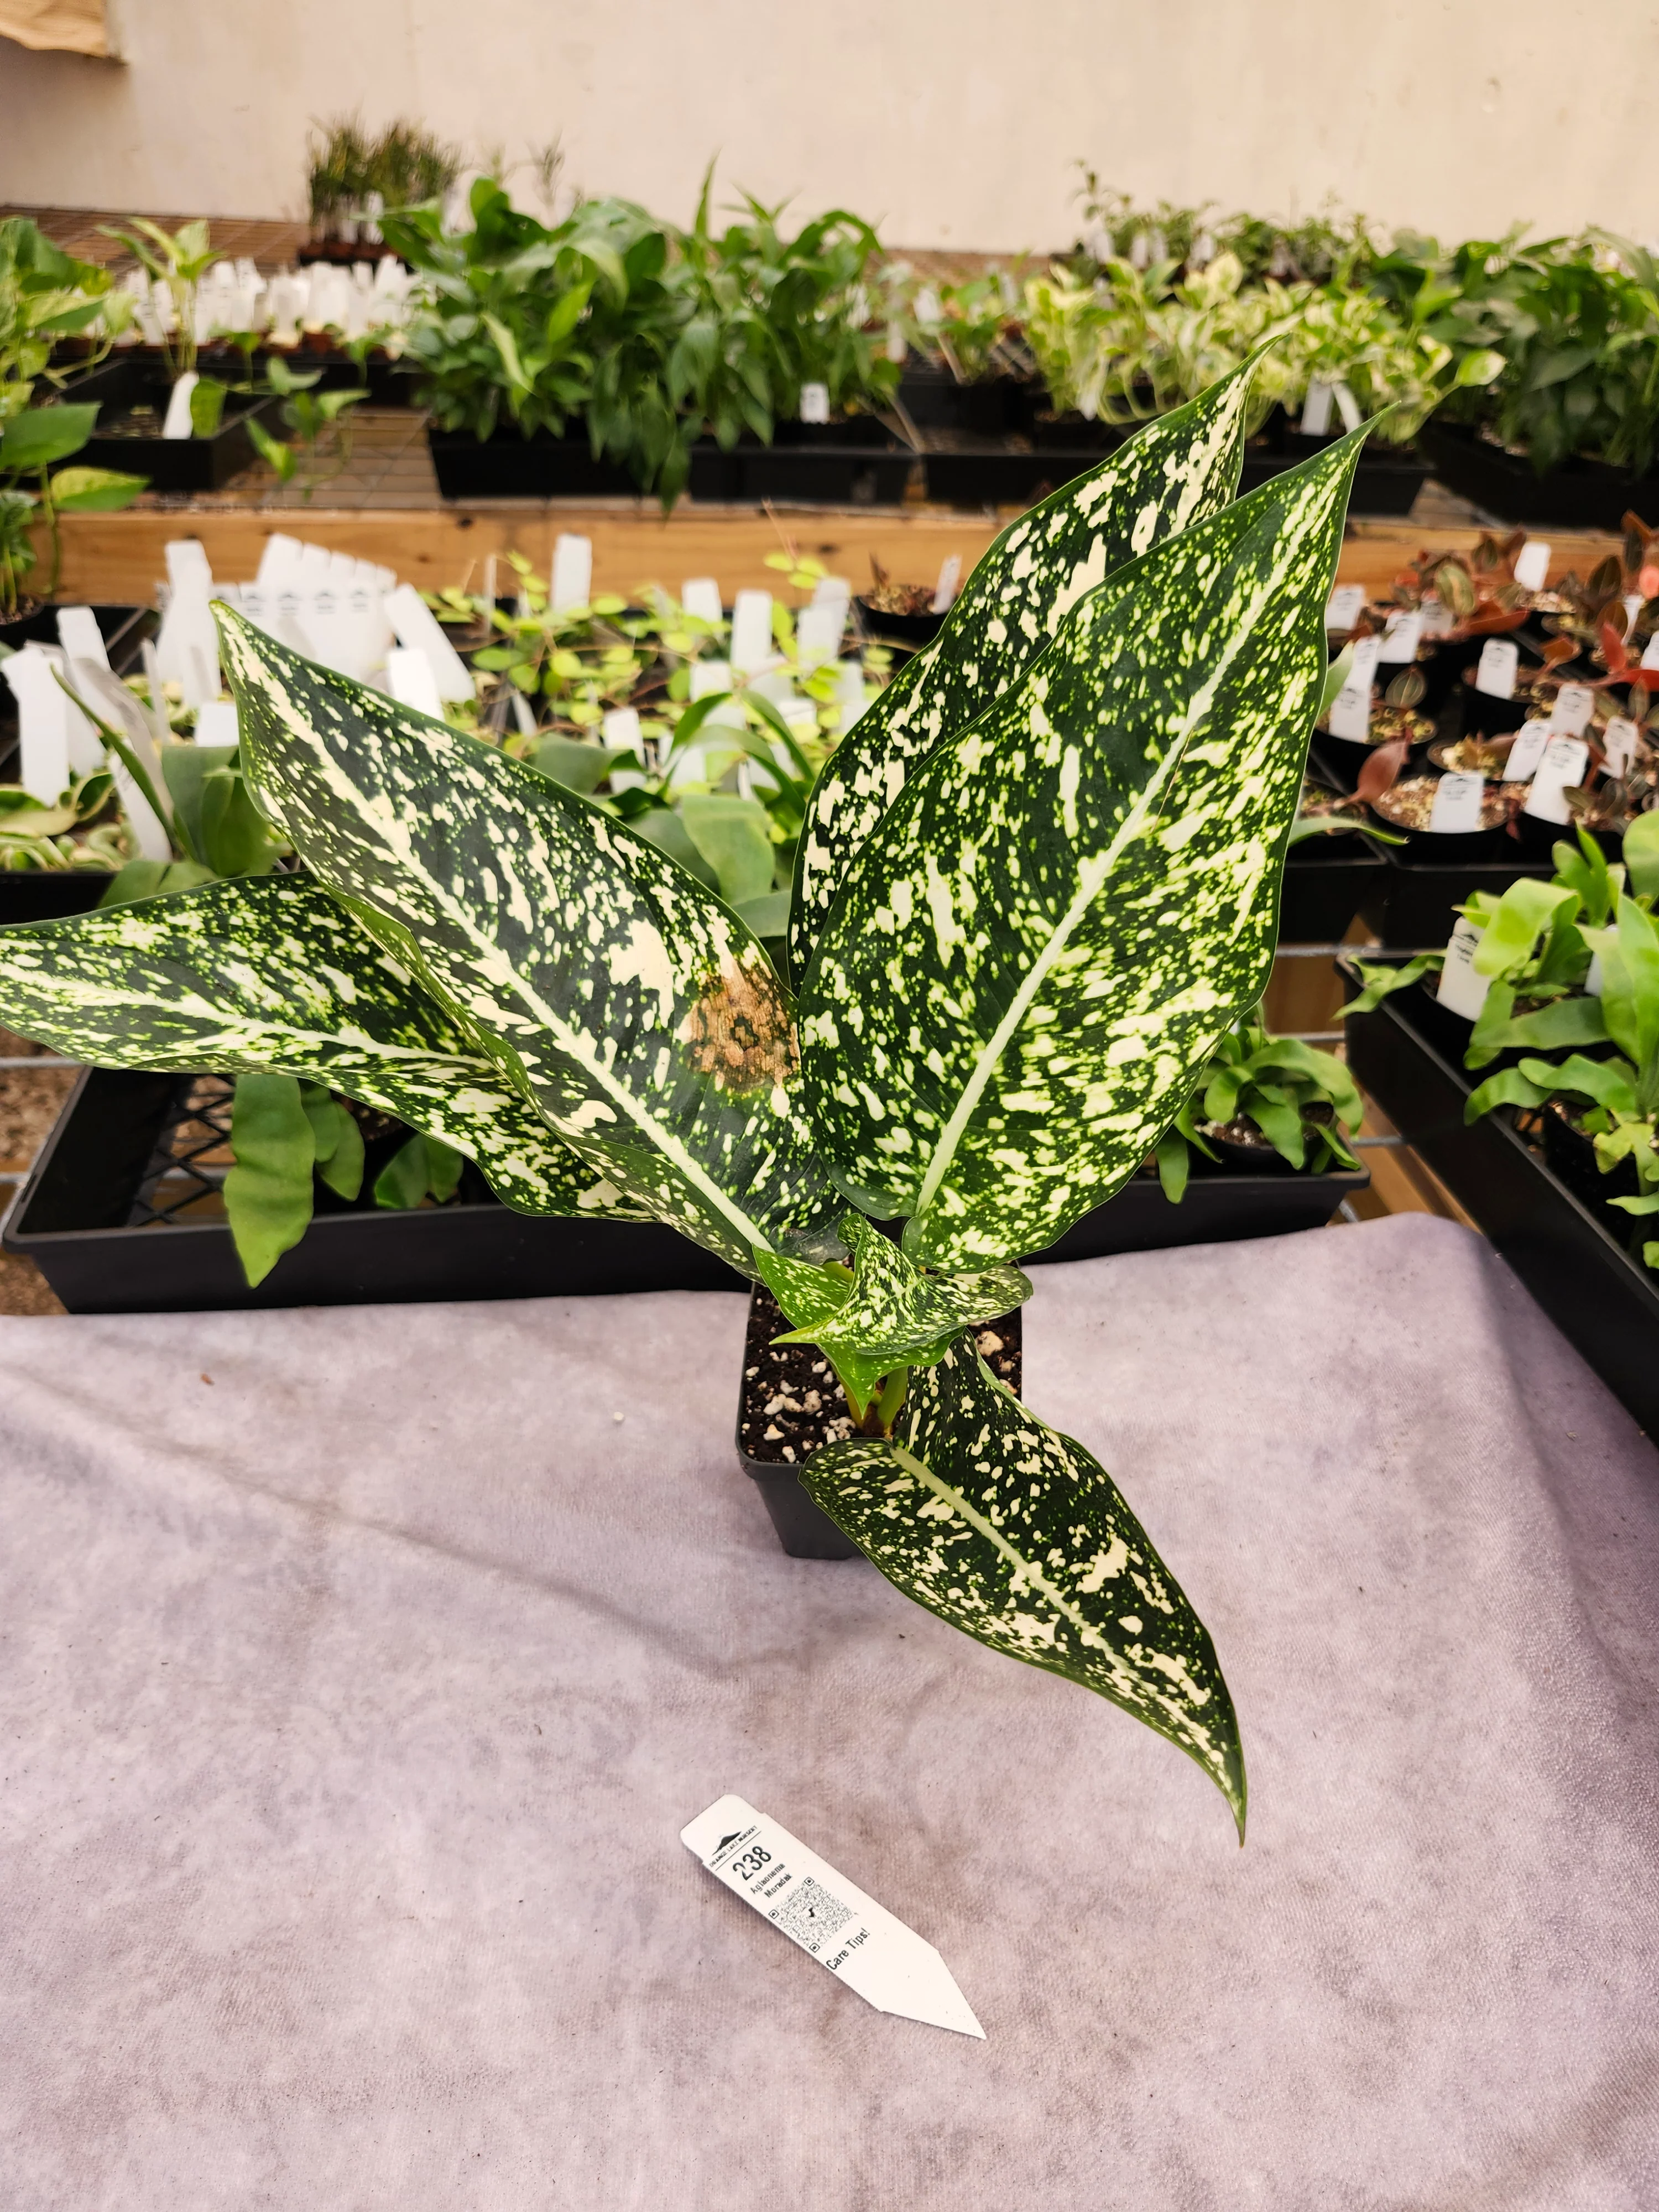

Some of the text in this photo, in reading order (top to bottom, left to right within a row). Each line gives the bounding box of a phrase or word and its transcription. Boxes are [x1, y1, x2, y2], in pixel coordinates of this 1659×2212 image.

[727, 1840, 739, 1852] LAKE
[738, 1825, 758, 1843] NURSERY
[732, 1846, 771, 1881] 238
[750, 1863, 785, 1894] Aglaonema
[826, 1927, 870, 1970] Care Tips!
